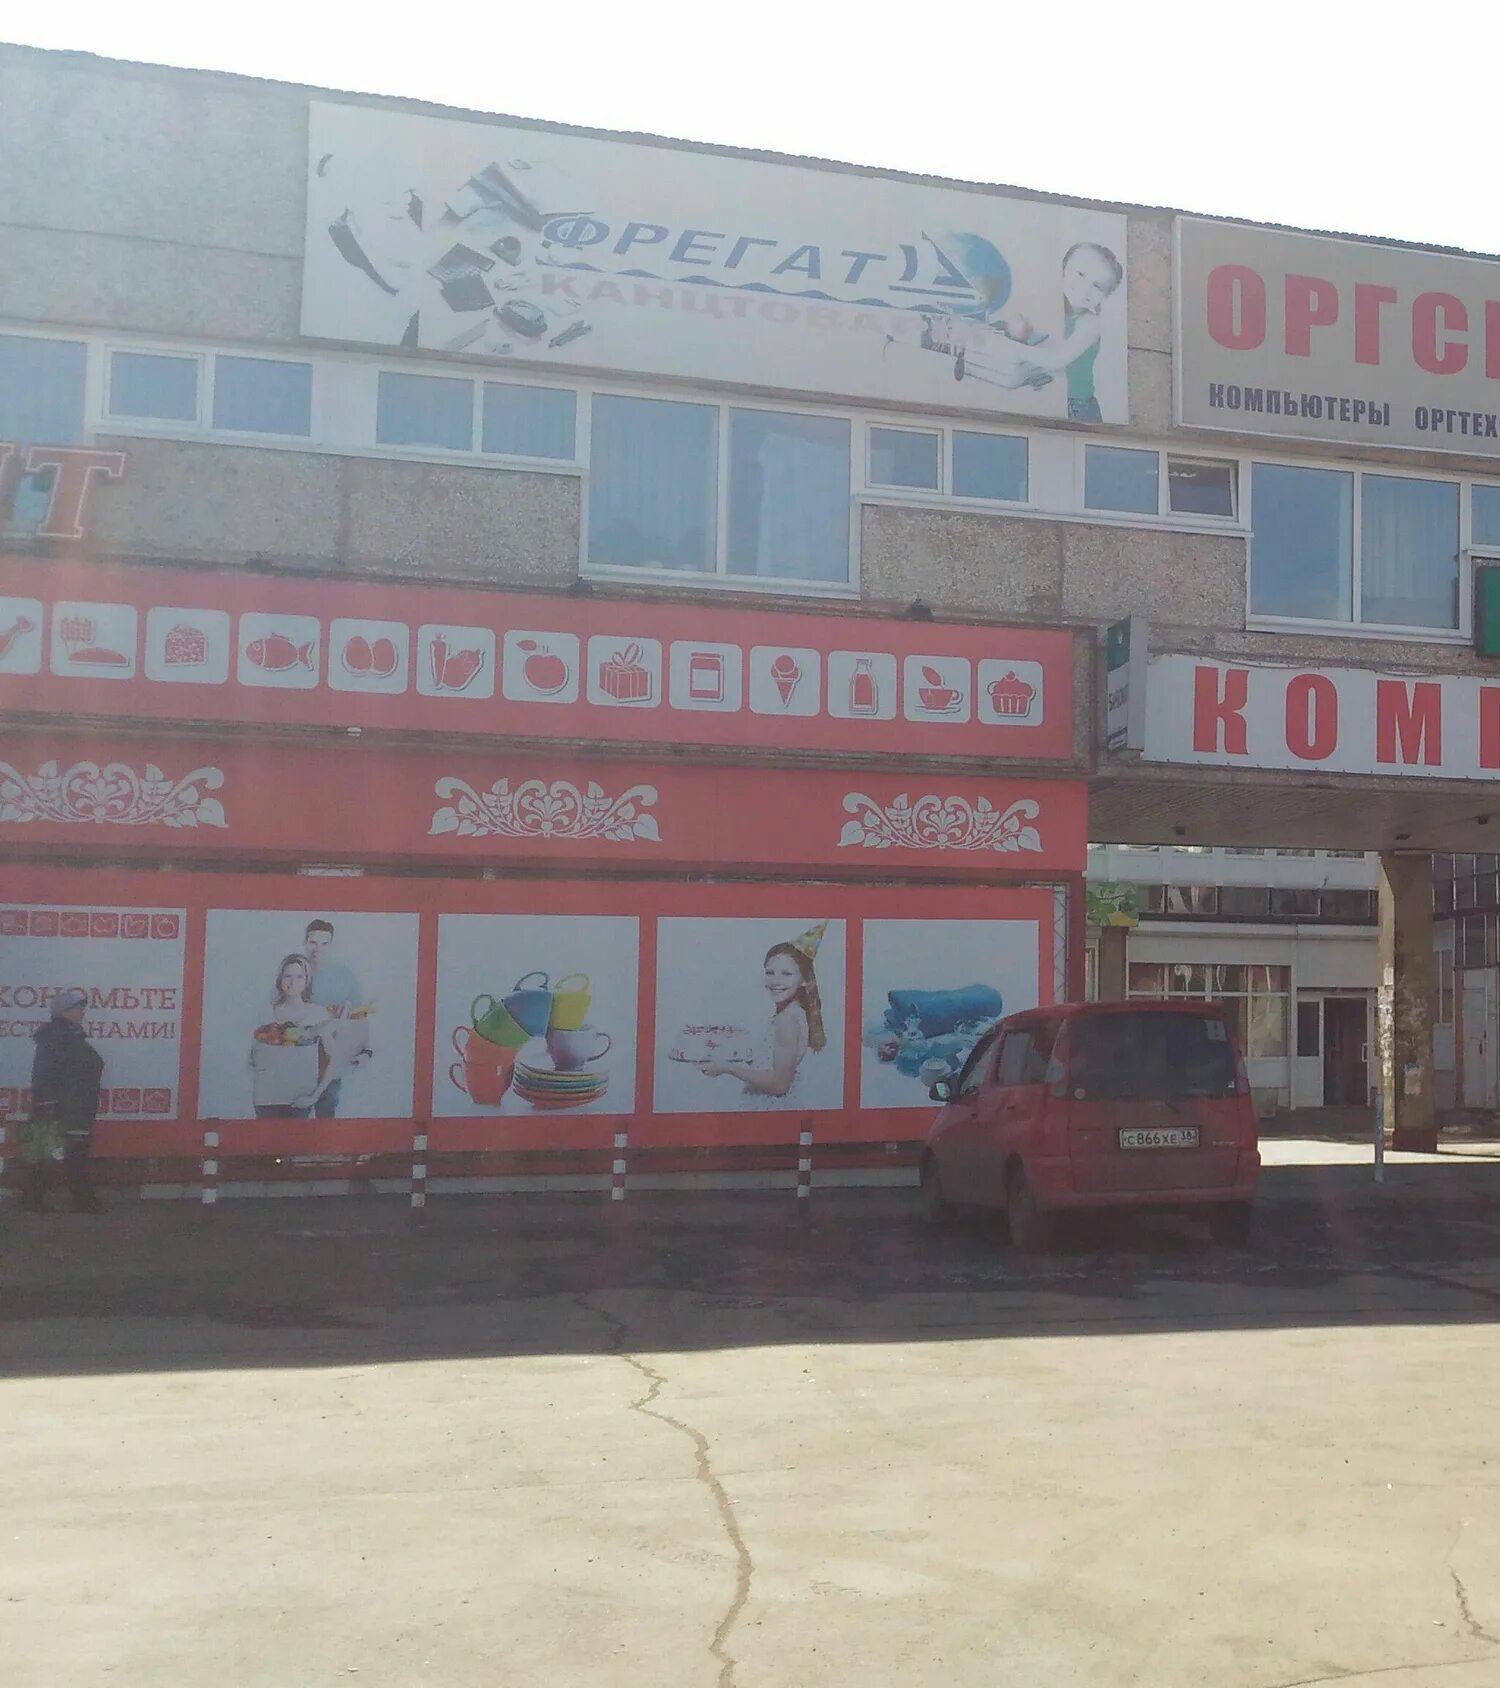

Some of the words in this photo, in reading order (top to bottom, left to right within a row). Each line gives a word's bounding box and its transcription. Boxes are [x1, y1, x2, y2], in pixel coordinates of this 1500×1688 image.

[543, 212, 887, 284] ФРЕГАТ
[1209, 383, 1390, 427] КОМПЬЮТЕРЫ
[88, 1021, 175, 1039] НАМИ!
